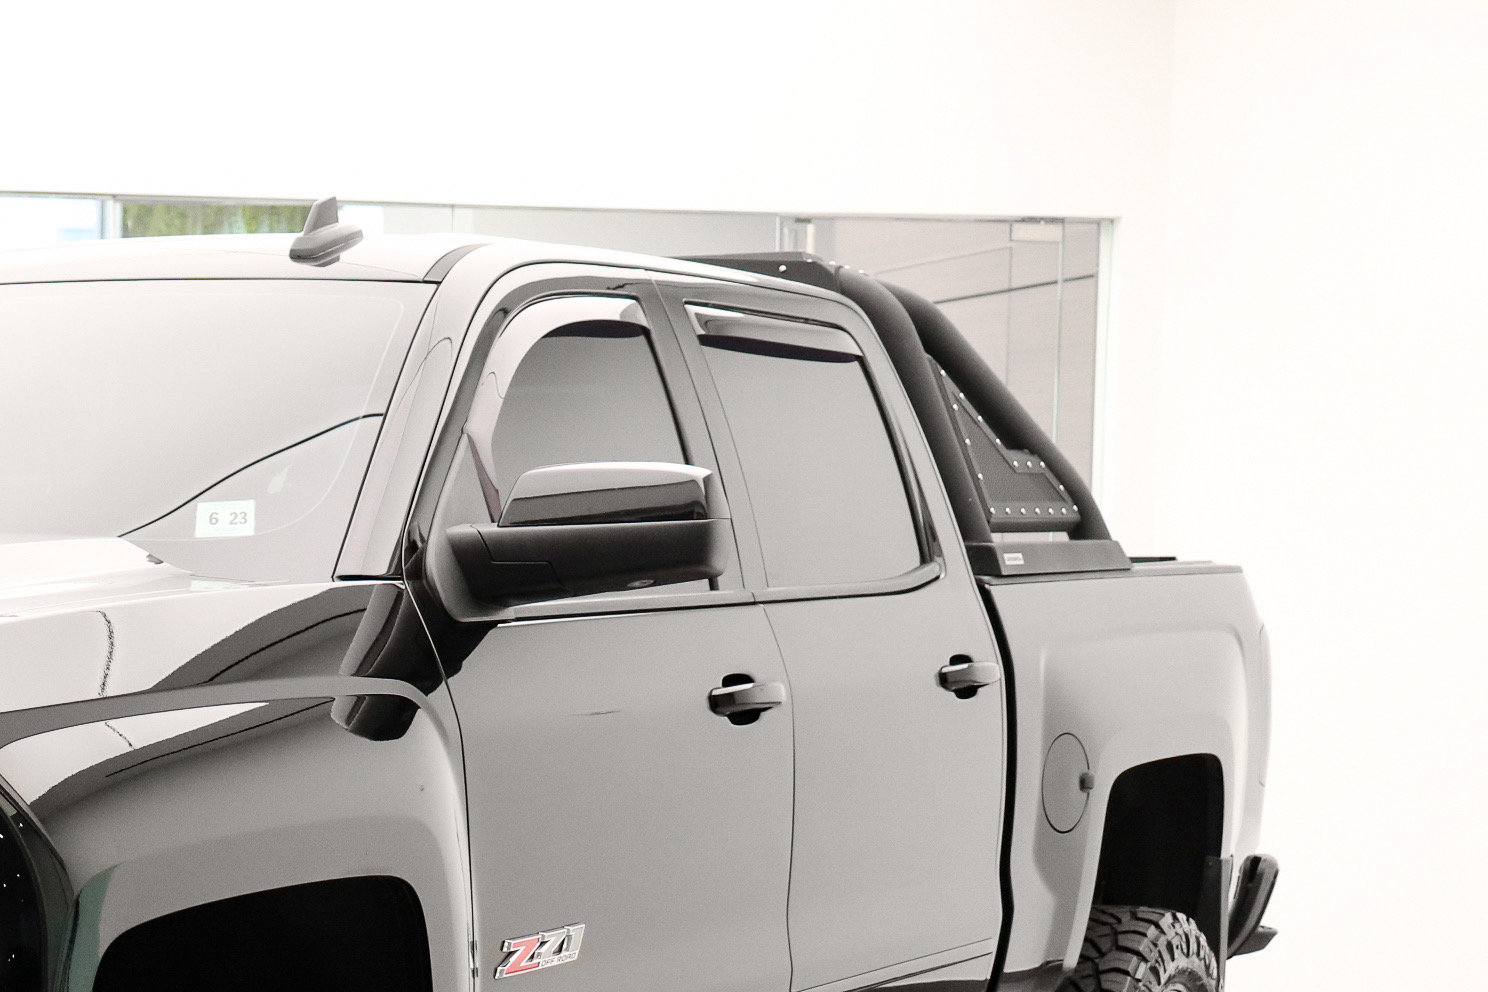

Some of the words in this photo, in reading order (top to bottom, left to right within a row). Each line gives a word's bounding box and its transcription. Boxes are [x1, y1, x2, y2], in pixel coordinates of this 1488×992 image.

[208, 511, 219, 525] 6
[229, 511, 248, 525] 23
[494, 922, 585, 980] Z71
